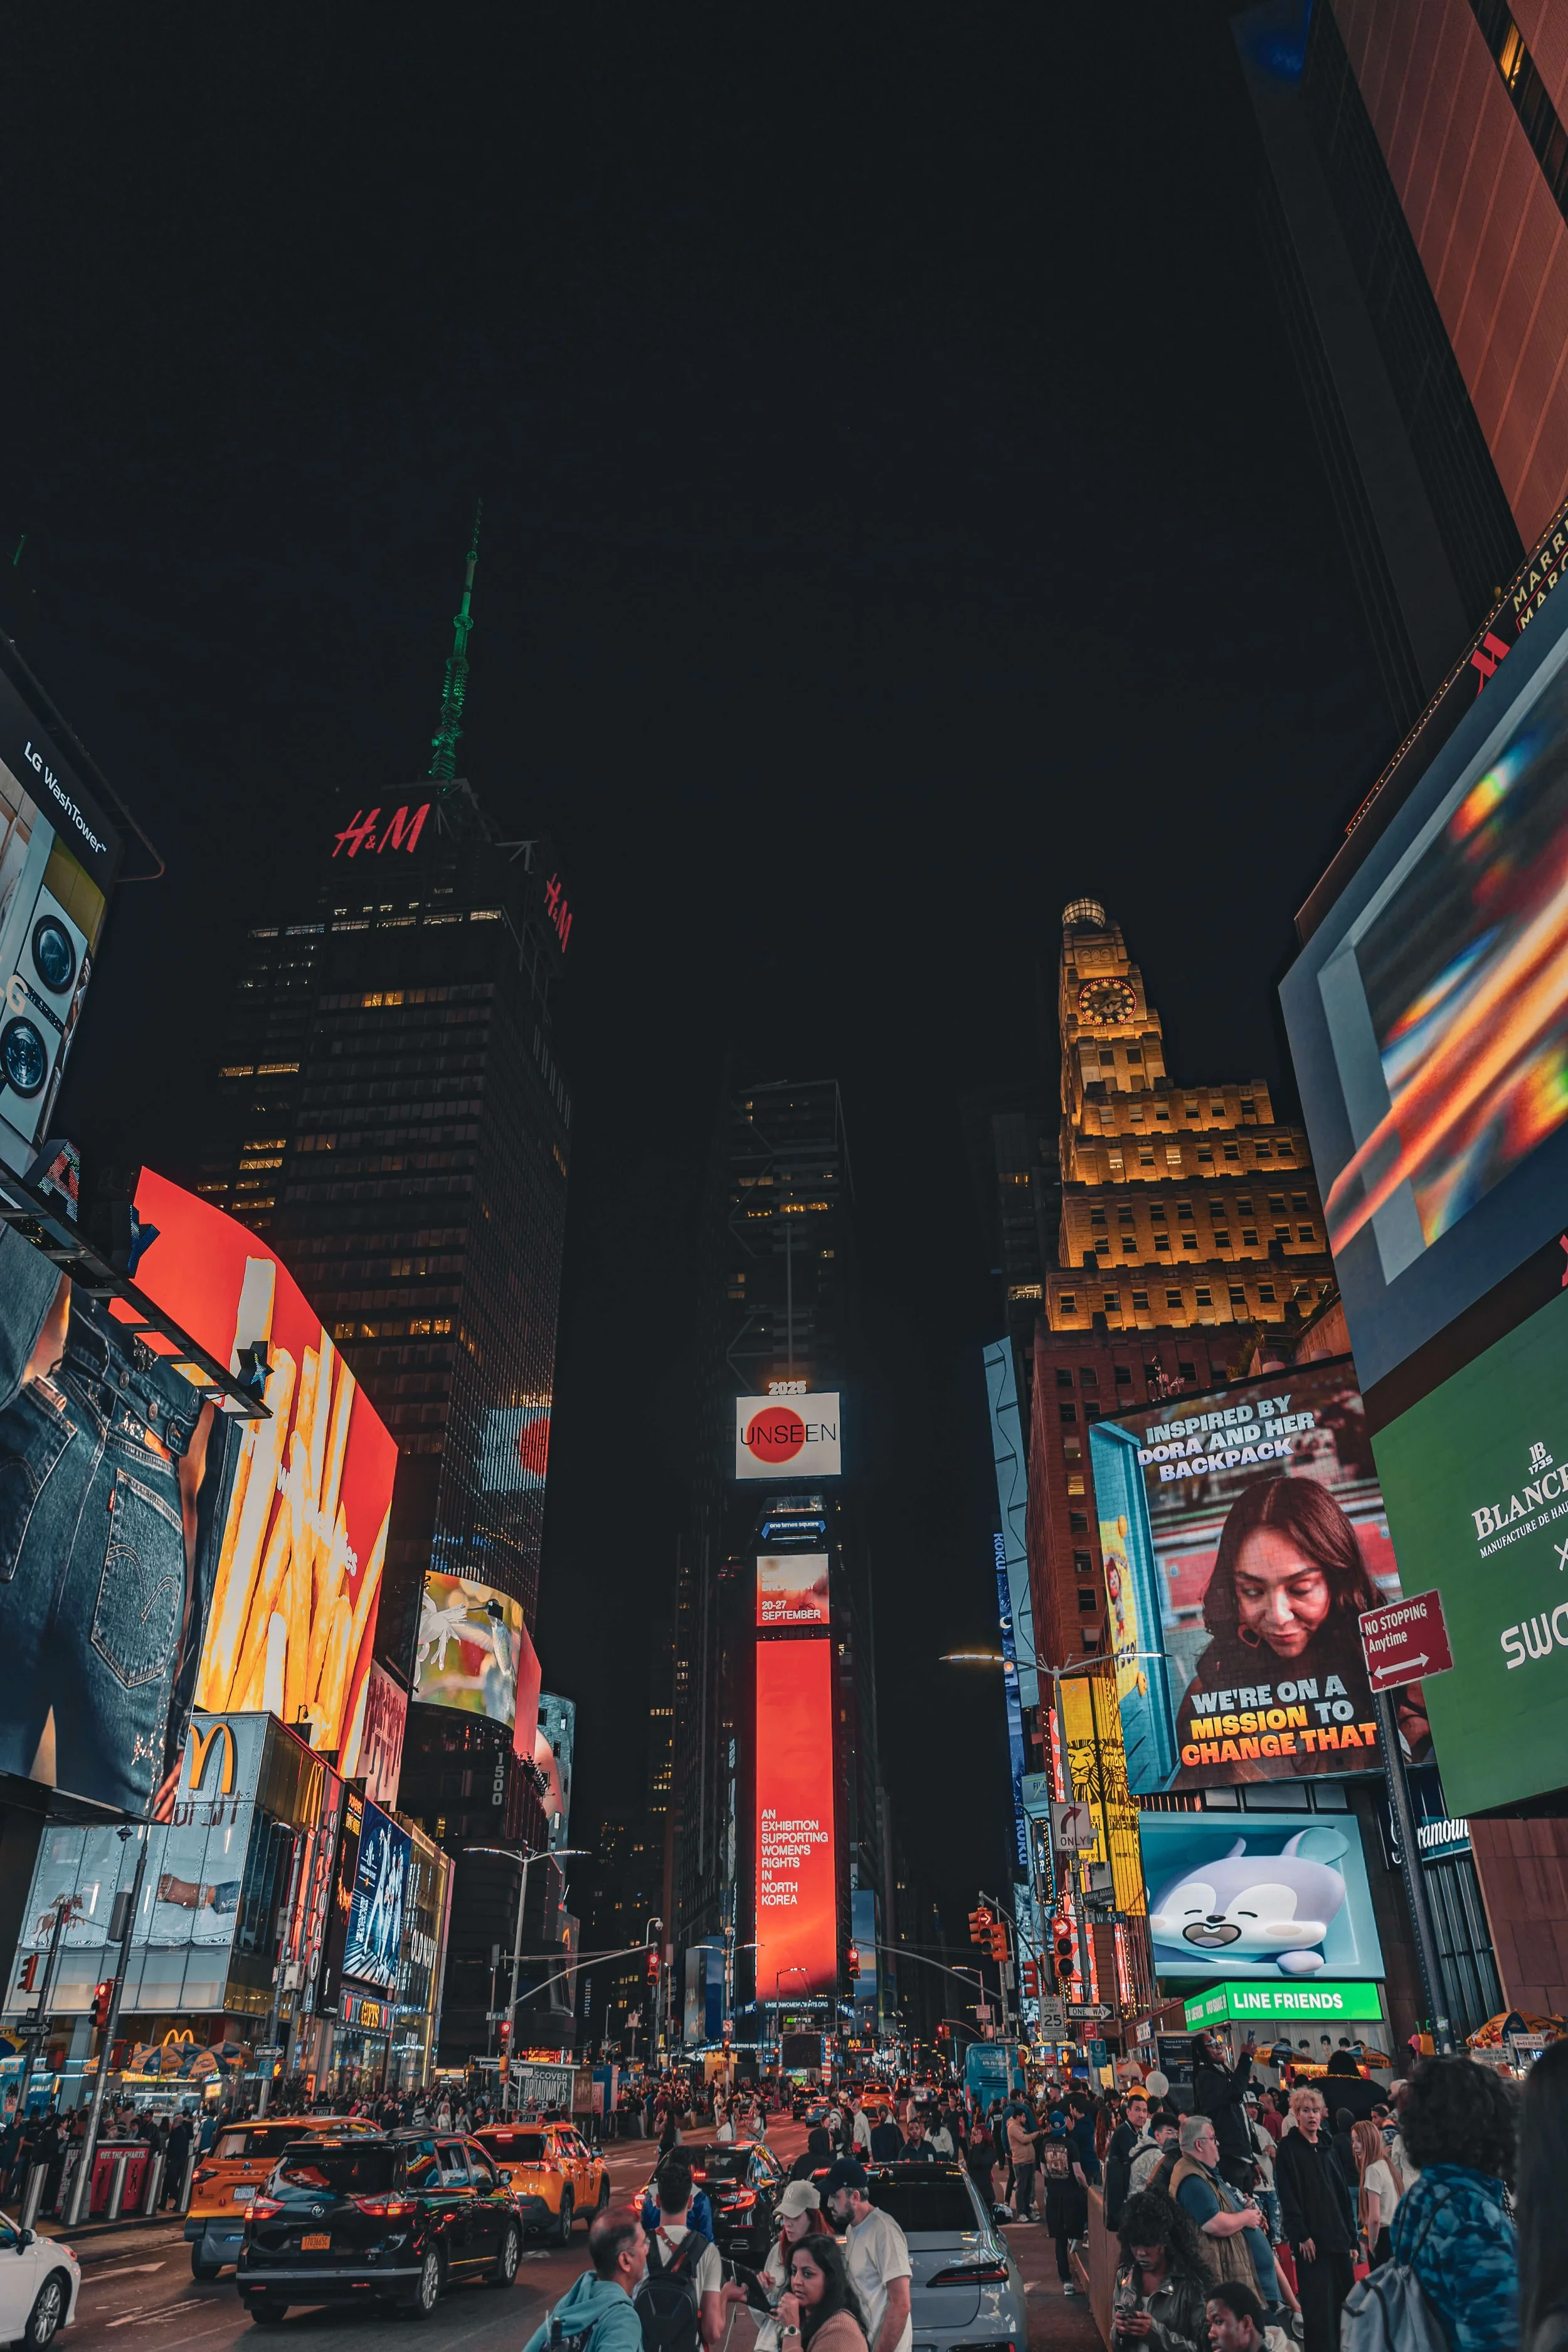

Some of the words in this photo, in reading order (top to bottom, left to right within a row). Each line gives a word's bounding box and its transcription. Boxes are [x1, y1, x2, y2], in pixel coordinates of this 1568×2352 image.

[24, 741, 43, 772] LG
[332, 803, 430, 857] H&M
[1145, 1405, 1253, 1445] INSPIRED
[1257, 1394, 1291, 1419] BY
[741, 1423, 836, 1445] UNSEEN
[1137, 1438, 1203, 1466] DORA
[1209, 1424, 1261, 1451] AND
[1264, 1412, 1315, 1438] HER
[1159, 1438, 1295, 1482] BACKPACK
[1528, 1454, 1553, 1475] 1735
[1480, 1519, 1537, 1559] MANUFACTURE
[1538, 1512, 1550, 1527] DE
[761, 1600, 787, 1610] 20-27
[761, 1609, 821, 1621] SEPTEMBER
[1364, 1619, 1379, 1636] NO
[1380, 1602, 1427, 1631] STOPPING
[1369, 1631, 1408, 1653] Anytime
[1191, 1684, 1273, 1714] WE'RE
[1276, 1677, 1319, 1703] ON
[1325, 1674, 1348, 1697] A
[1190, 1705, 1308, 1740] MISSION
[1314, 1700, 1354, 1724] TO
[1181, 1730, 1297, 1766] CHANGE
[1299, 1722, 1377, 1753] THAT
[492, 1752, 504, 1806] 1500
[761, 1809, 776, 1819] AN
[761, 1820, 819, 1831] EXHIBITION
[761, 1832, 829, 1844] SUPPORTING
[1061, 1836, 1086, 1846] ONLY
[761, 1845, 811, 1855] WOMEN'S
[761, 1857, 800, 1868] RIGHTS
[761, 1870, 772, 1880] IN
[761, 1882, 798, 1893] NORTH
[1084, 1892, 1098, 1900] George
[761, 1894, 798, 1905] KOREA
[1096, 1914, 1103, 1922] W
[1107, 1913, 1116, 1922] 45
[422, 1935, 438, 1970] NAVY
[1233, 1993, 1272, 2009] LINE
[1273, 1993, 1343, 2009] FRIENDS
[361, 2001, 380, 2028] GIFTS
[1044, 2015, 1062, 2026] 25
[526, 2072, 568, 2081] SCOVER
[524, 2079, 567, 2102] BROADWAY'S
